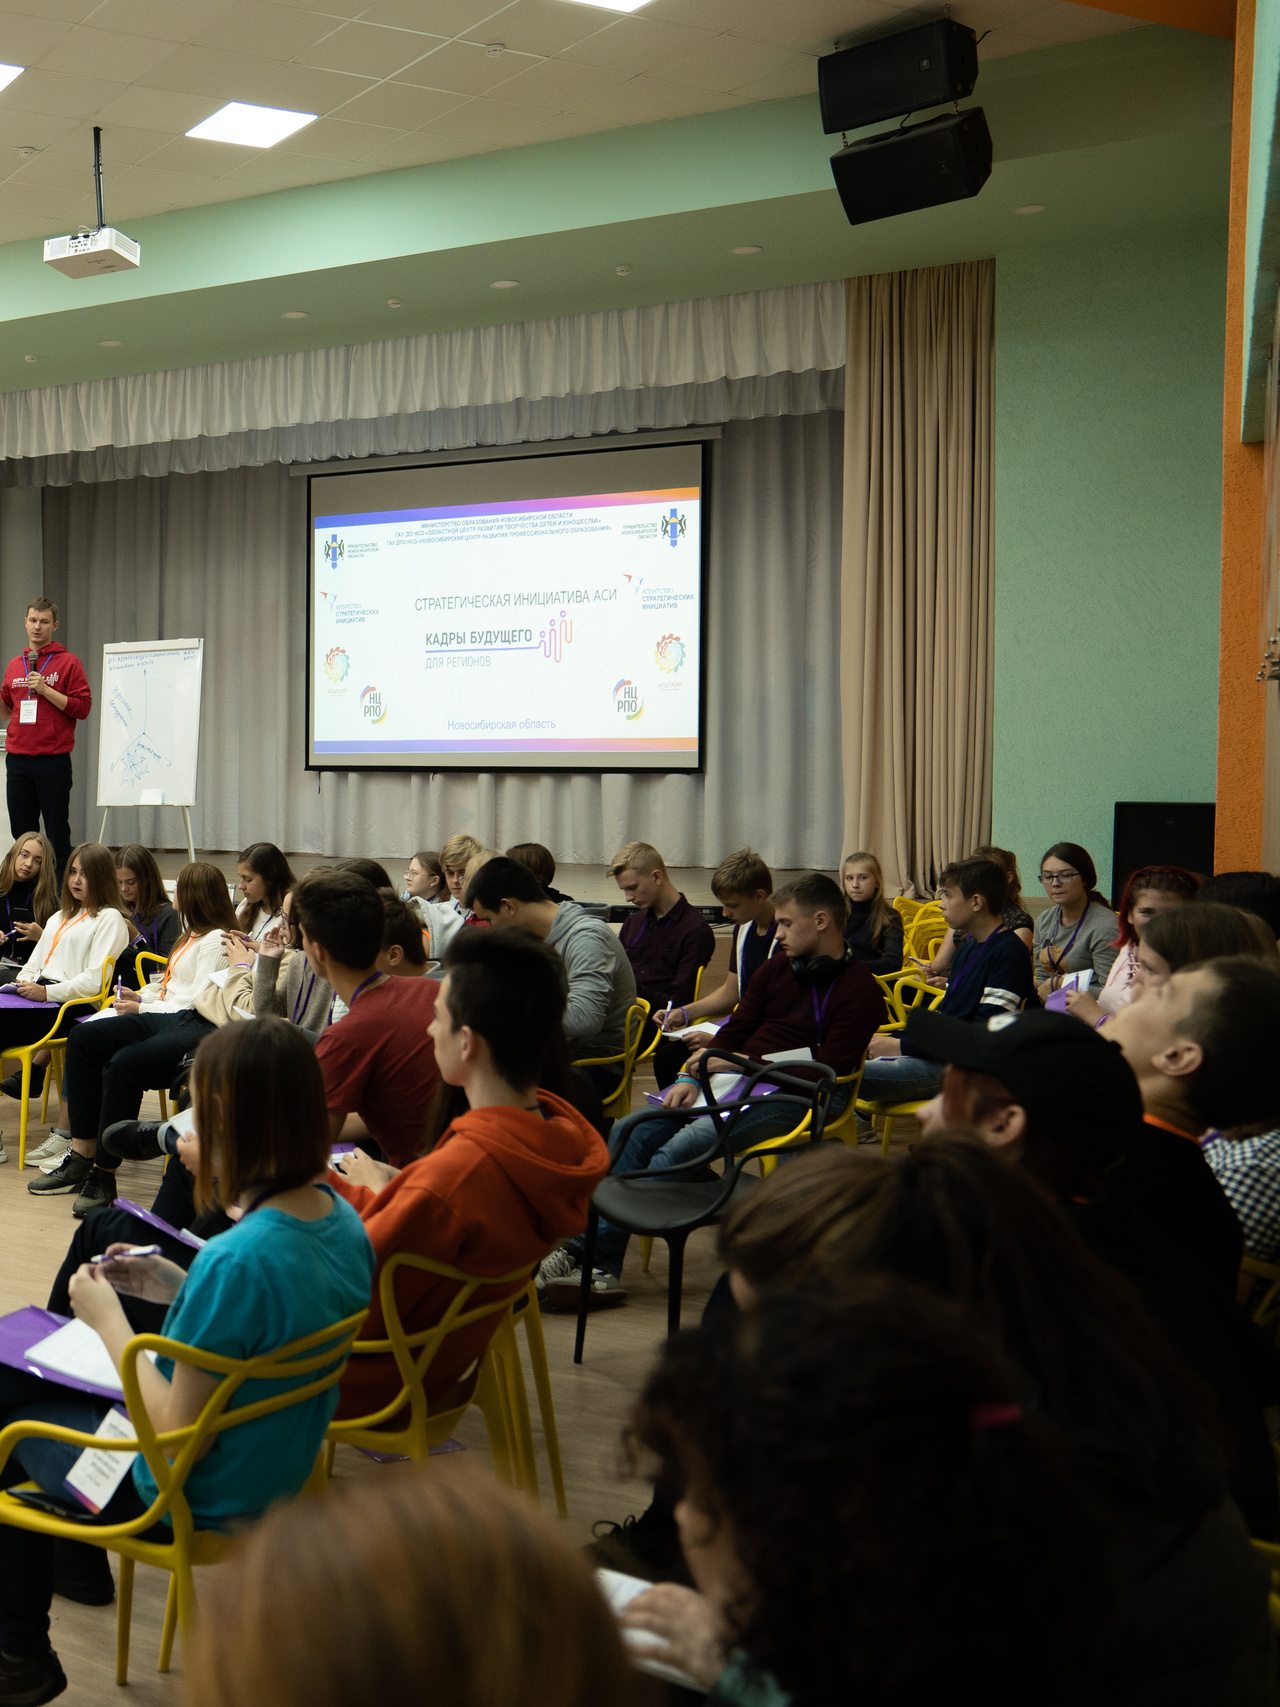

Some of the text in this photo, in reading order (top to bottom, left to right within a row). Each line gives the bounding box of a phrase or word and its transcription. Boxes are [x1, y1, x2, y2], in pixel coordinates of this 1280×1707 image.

[421, 520, 460, 528] МИНИСТЕРСТВО
[482, 531, 508, 539] РАЗВИТИЯ
[509, 528, 569, 538] ПРОФЕССИОНАЛЬНОГО
[415, 588, 617, 611] СТРАТЕГИЧЕСКАЯ ИНИЦИАТИВА АСИ
[425, 629, 532, 647] КАДРЫ БУДУЩЕГО
[425, 656, 491, 670] ДЛЯ РЕГИОНОВ
[370, 692, 381, 706] НЦ
[624, 686, 637, 700] НЦ
[364, 705, 381, 717] РПО
[617, 700, 637, 712] РПО
[447, 718, 556, 731] Новосибирская область
